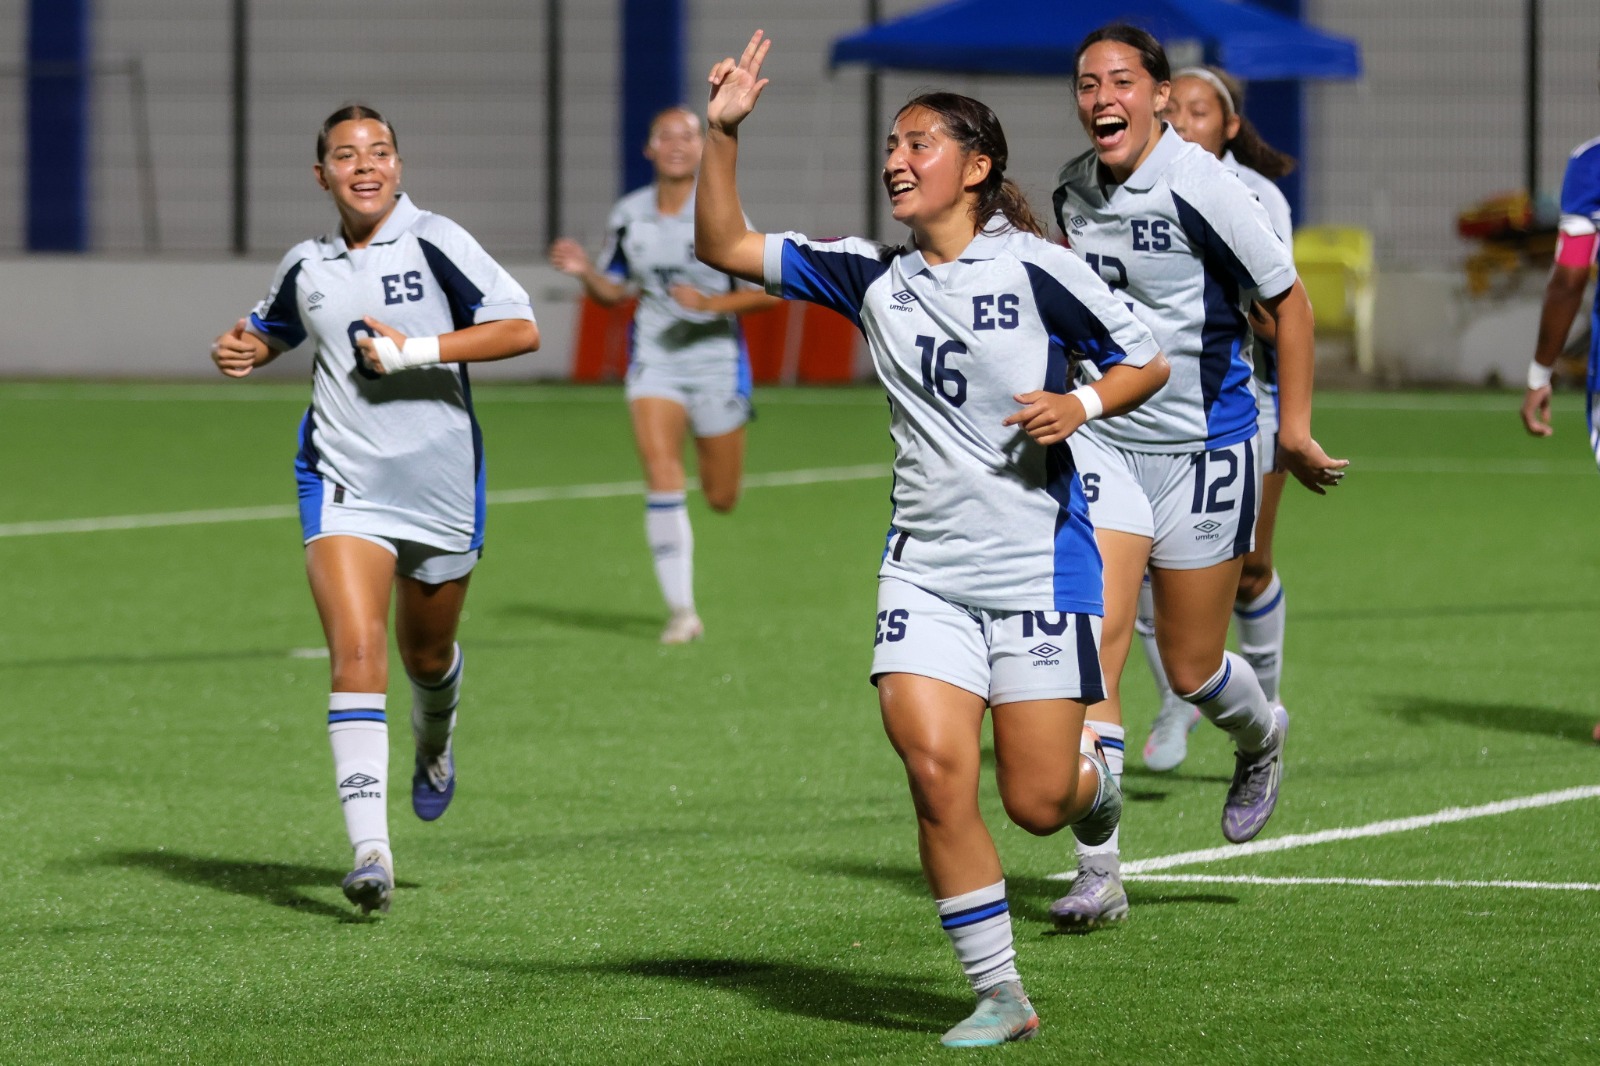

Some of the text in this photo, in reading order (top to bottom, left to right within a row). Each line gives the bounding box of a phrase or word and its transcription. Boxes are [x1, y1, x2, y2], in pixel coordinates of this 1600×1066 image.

[1130, 219, 1172, 252] ES
[381, 270, 425, 306] ES
[889, 304, 913, 313] umbro
[972, 293, 1020, 331] ES
[914, 334, 968, 409] 16
[1081, 472, 1101, 503] S
[1189, 448, 1238, 515] 12
[1195, 532, 1219, 541] umbro
[873, 608, 910, 648] ES
[1032, 658, 1060, 667] umbro
